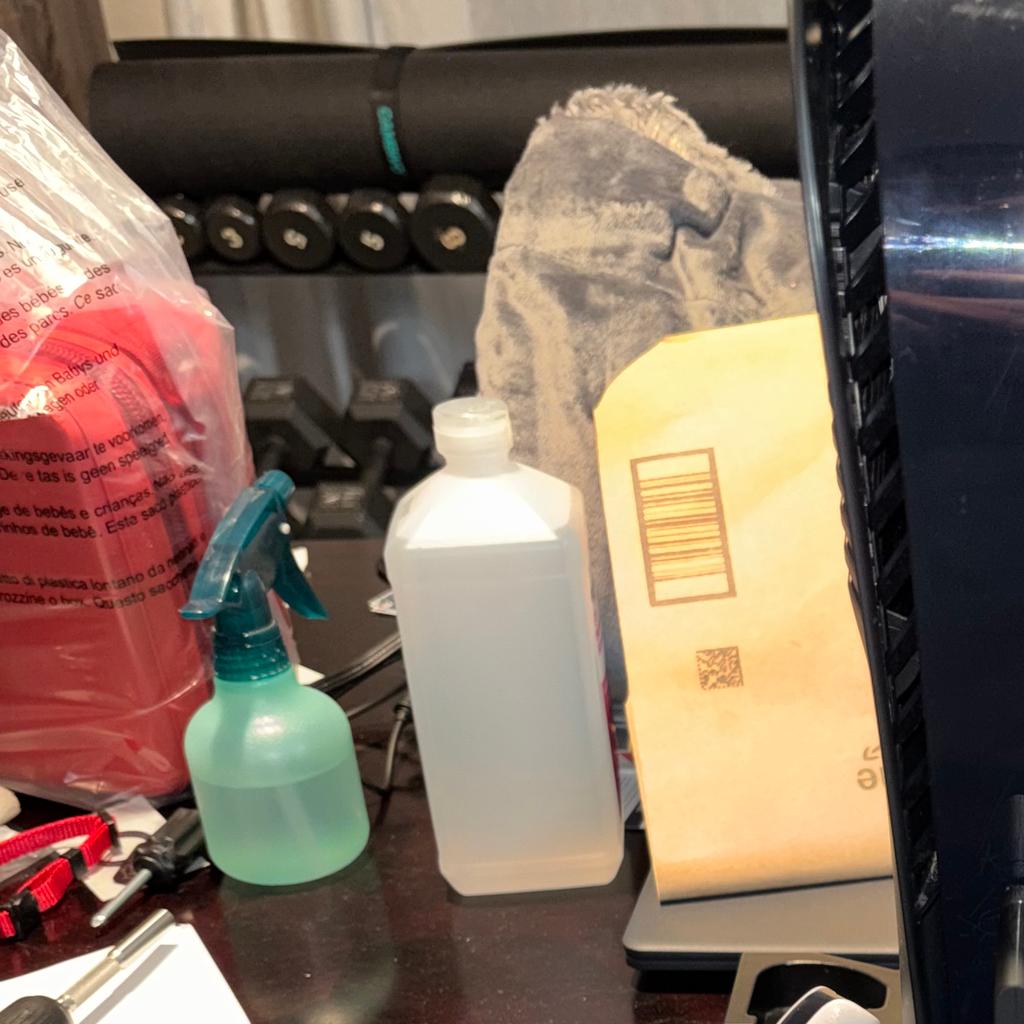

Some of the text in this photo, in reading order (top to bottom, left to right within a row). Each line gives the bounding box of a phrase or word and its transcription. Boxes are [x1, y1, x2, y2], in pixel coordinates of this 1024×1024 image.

[84, 263, 111, 280] des
[0, 328, 28, 349] des
[74, 293, 91, 310] Ce
[52, 343, 120, 384] Babys und
[75, 380, 100, 398] oder
[93, 442, 106, 455] te
[37, 469, 60, 483] tas
[62, 468, 76, 482] is
[80, 460, 117, 485] geen
[79, 509, 90, 520] e
[41, 524, 59, 537] de
[105, 515, 139, 535] Este
[147, 563, 166, 578] da
